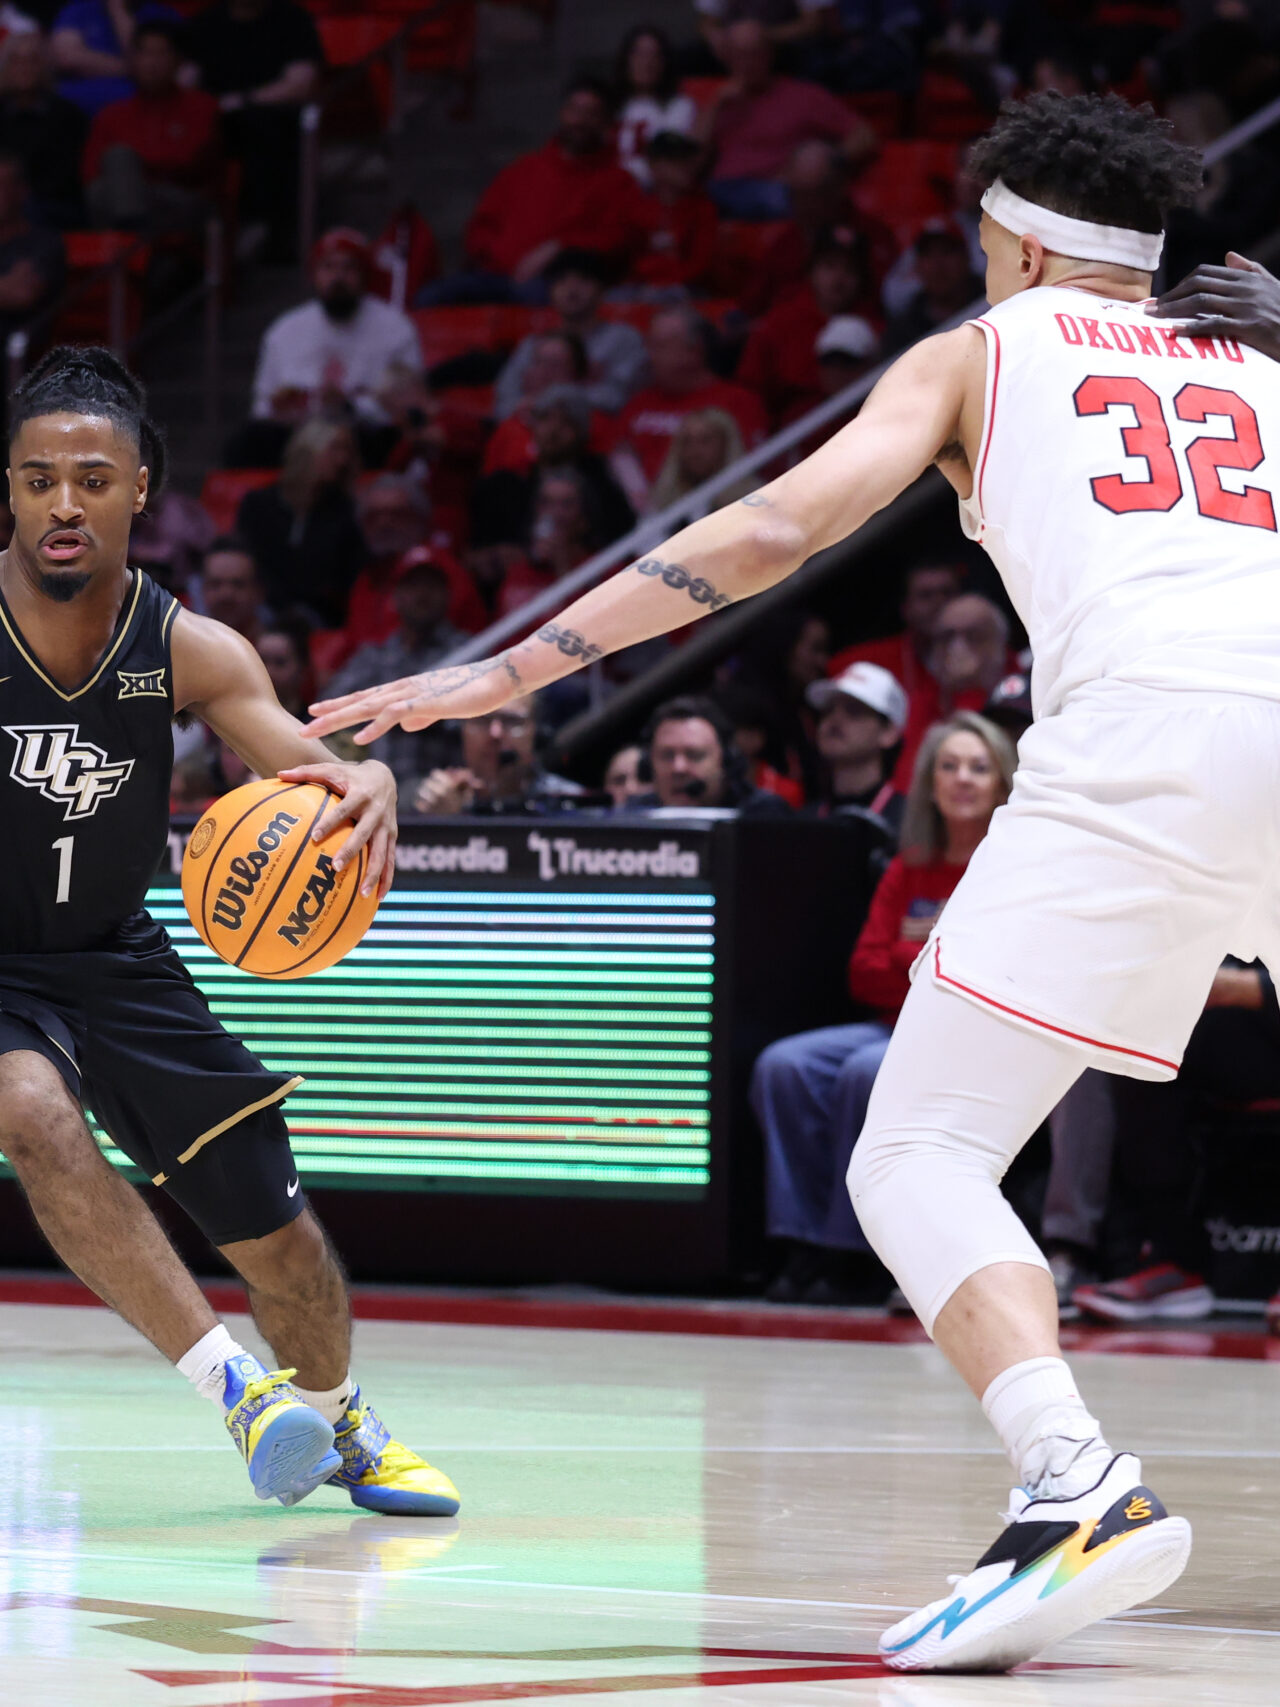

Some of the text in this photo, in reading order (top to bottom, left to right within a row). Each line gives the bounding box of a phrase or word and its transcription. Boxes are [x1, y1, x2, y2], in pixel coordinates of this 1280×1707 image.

[1054, 313, 1245, 364] OKONKWO
[1072, 375, 1278, 533] 32
[6, 726, 132, 820] UCF
[51, 835, 75, 904] 1
[212, 811, 300, 931] Wilson
[395, 836, 507, 873] ucordia
[555, 838, 700, 878] Trucordia
[277, 853, 337, 948] NCAA
